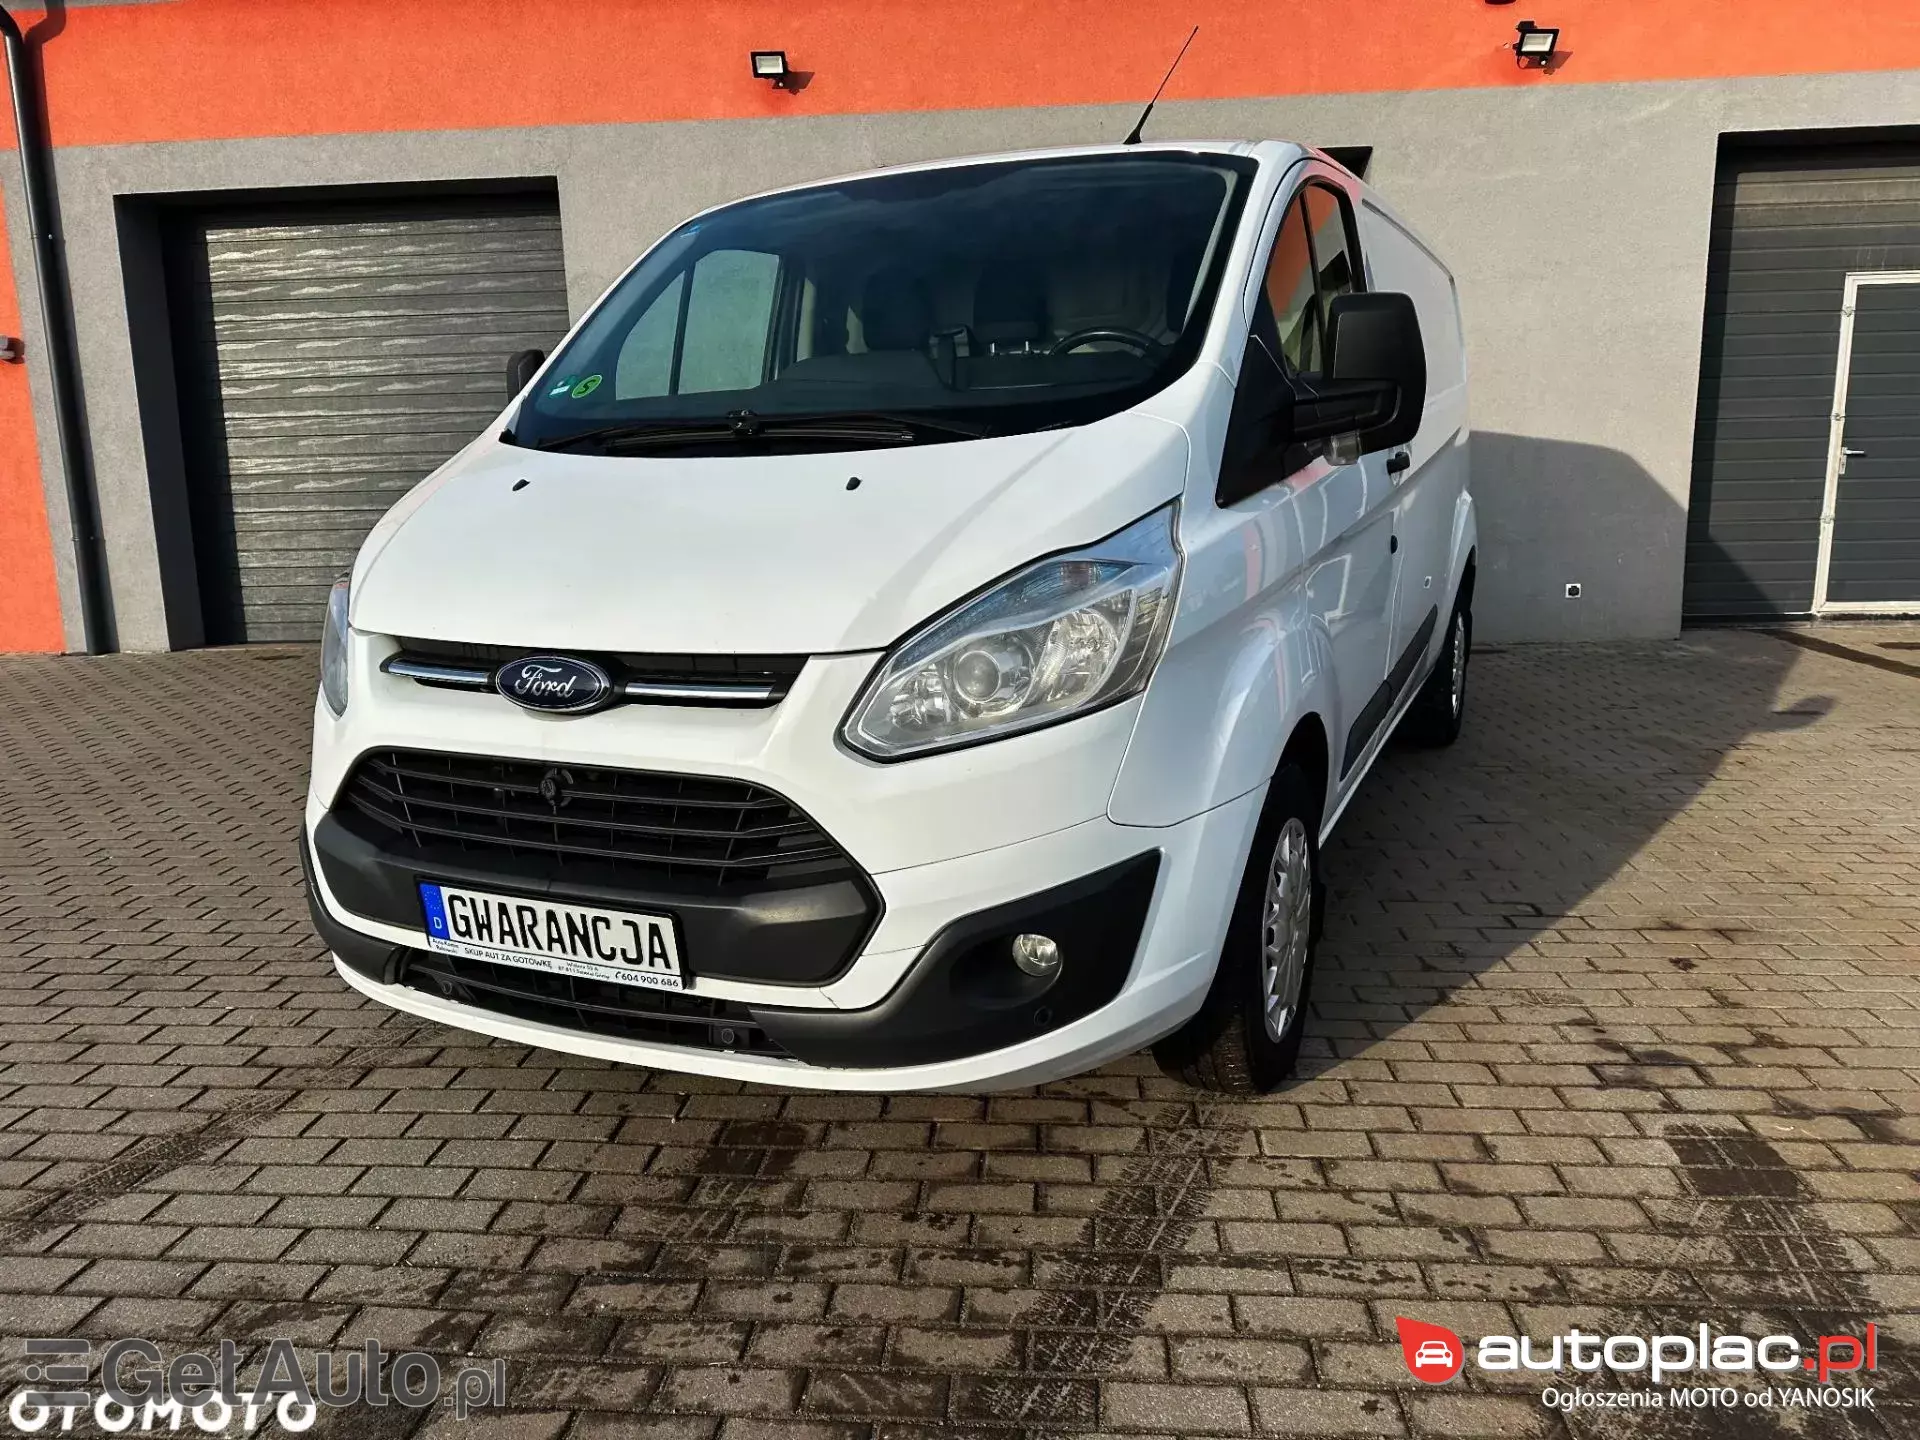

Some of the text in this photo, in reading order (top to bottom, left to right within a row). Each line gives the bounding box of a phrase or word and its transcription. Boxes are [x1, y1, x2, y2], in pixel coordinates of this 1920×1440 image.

[514, 664, 577, 698] Ford
[433, 916, 442, 929] D
[447, 894, 672, 970] GWARANCJA
[464, 947, 484, 956] SKUP
[485, 951, 499, 960] AUT
[500, 953, 512, 961] ZA
[621, 973, 679, 987] 604 900 686
